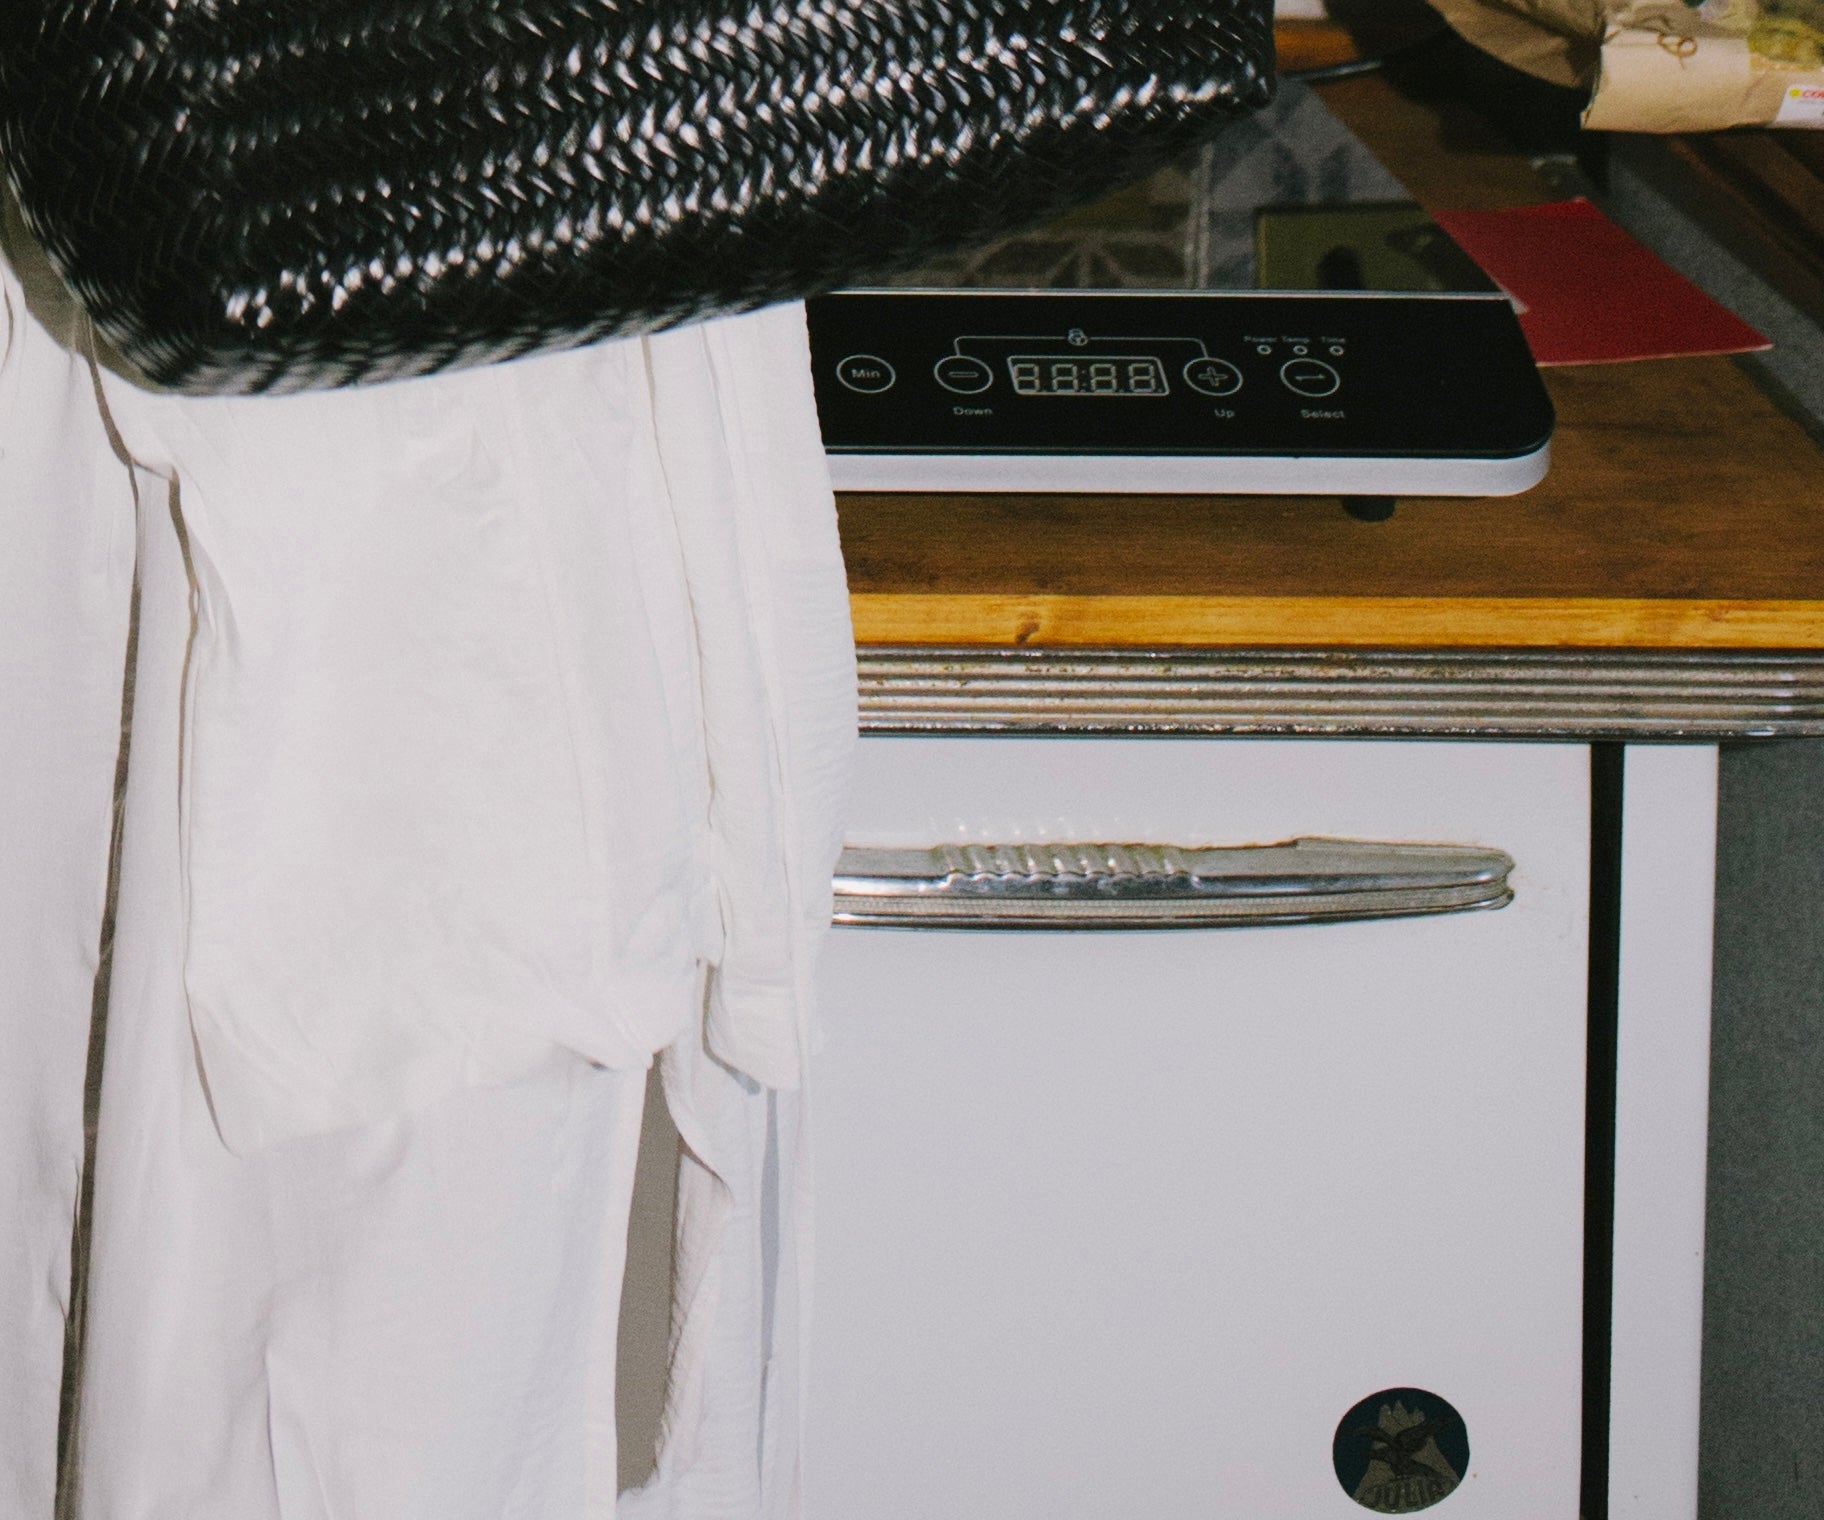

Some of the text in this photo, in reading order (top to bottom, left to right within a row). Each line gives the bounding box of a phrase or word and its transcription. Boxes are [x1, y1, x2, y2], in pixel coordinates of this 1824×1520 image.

[851, 369, 880, 378] Min
[953, 406, 993, 415] Down
[1214, 409, 1236, 419] Up
[1301, 409, 1346, 419] Select
